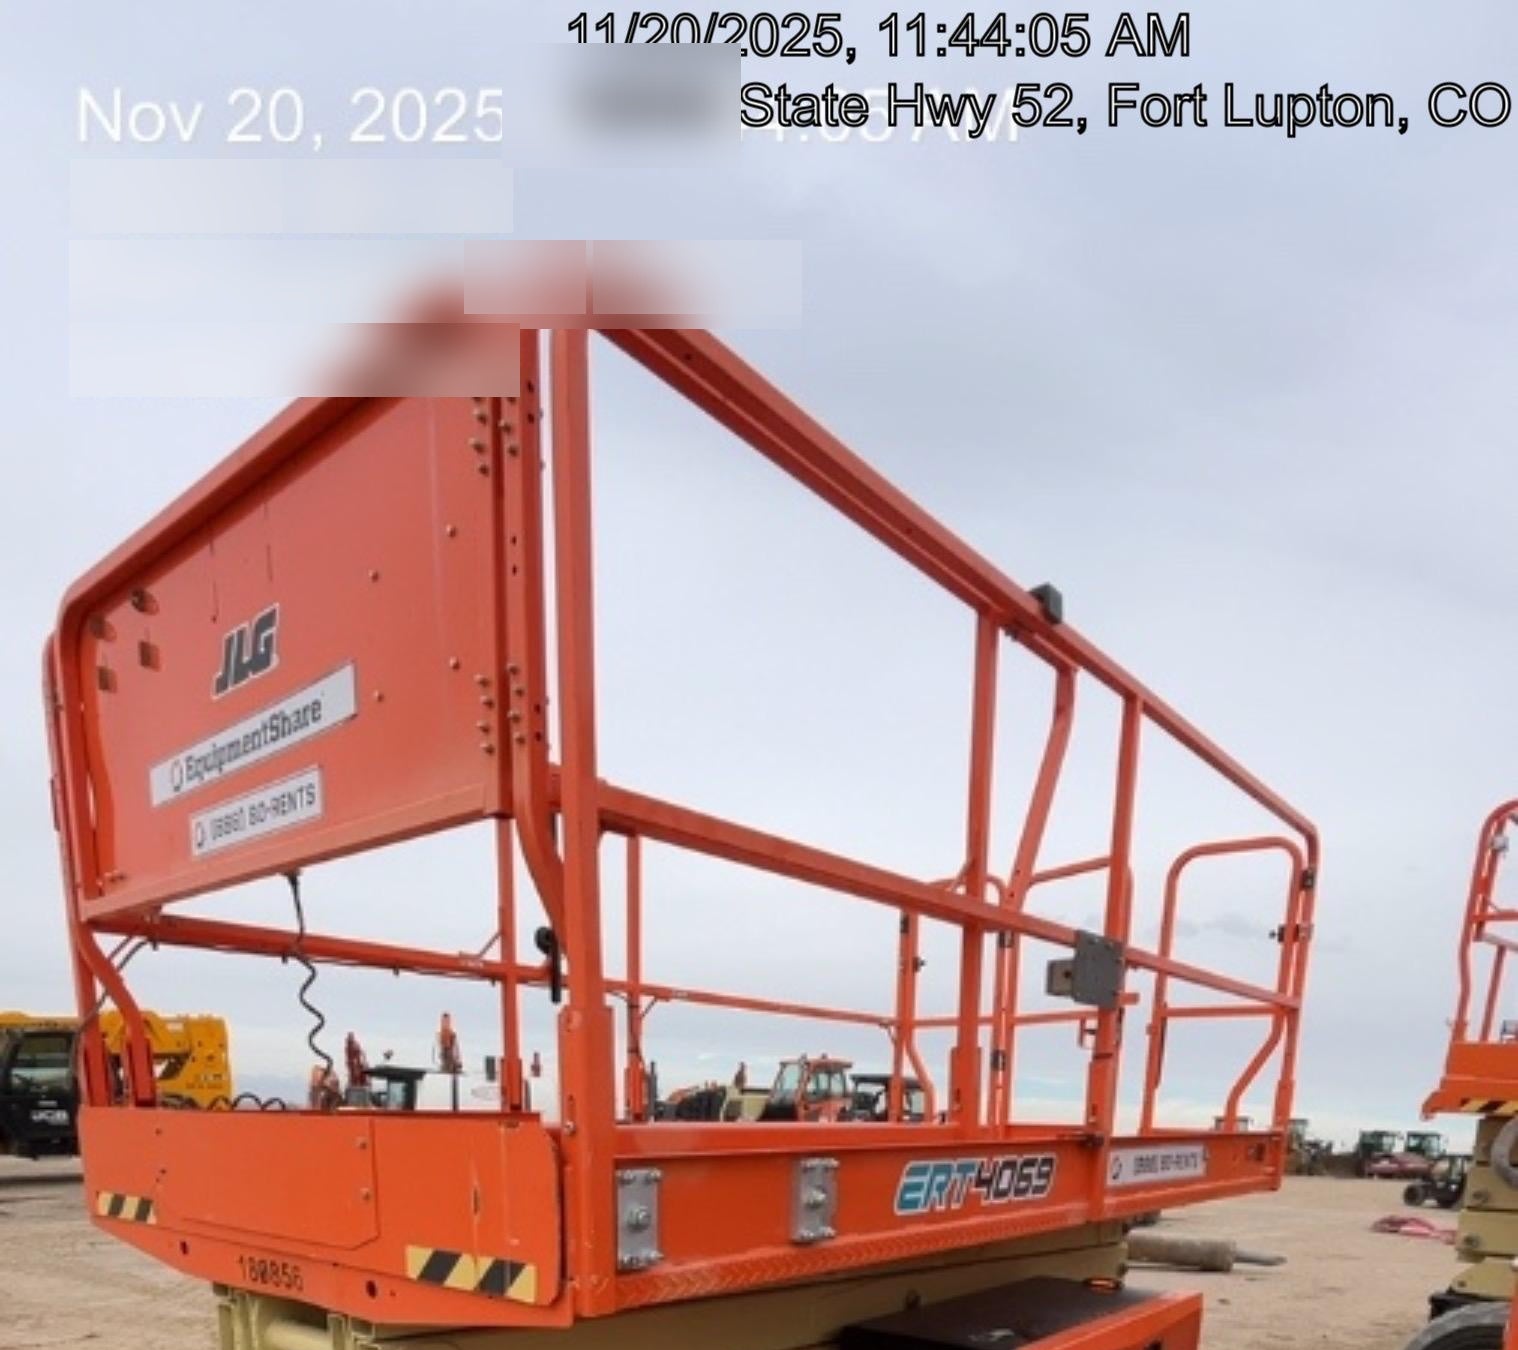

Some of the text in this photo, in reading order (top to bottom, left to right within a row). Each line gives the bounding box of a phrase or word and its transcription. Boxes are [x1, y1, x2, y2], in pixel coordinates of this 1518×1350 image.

[213, 604, 279, 698] JLG
[184, 698, 323, 781] EquipmentShare
[896, 1154, 1055, 1213] ERT4069
